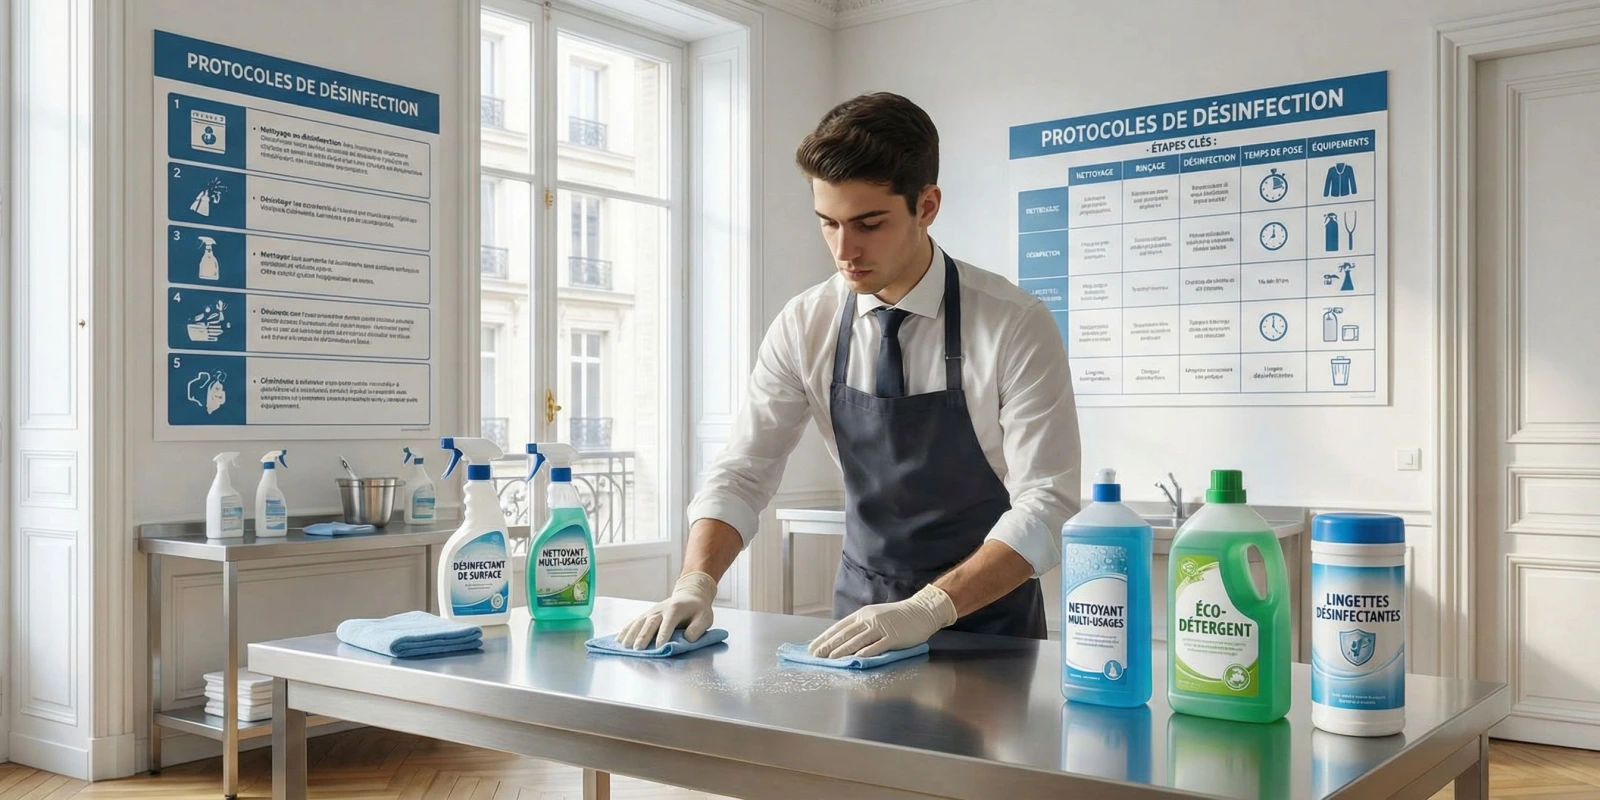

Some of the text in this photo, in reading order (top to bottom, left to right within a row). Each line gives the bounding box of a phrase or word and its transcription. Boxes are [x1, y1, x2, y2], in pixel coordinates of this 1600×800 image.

[187, 52, 419, 118] PROTOCOLES DE DÉSINFECTION
[174, 98, 180, 109] 1
[1041, 87, 1345, 148] PROTOCOLES DE DÉSINFECTION
[1151, 138, 1186, 154] ÉTAPES
[1188, 136, 1212, 149] CLÉS
[1311, 136, 1370, 153] ÉQUIPEMENTS
[1183, 152, 1237, 168] DÉSINFECTION
[1243, 145, 1304, 161] TEMPS DE POSE
[173, 167, 182, 178] 2
[1076, 168, 1114, 180] NETTOYAGE
[1135, 161, 1167, 174] RINÇAGE
[173, 230, 181, 241] 3
[172, 292, 181, 303] 4
[173, 357, 181, 369] 5
[542, 548, 585, 558] NETTOYANT
[453, 559, 506, 571] DÉSINFECTANT
[538, 556, 588, 567] MULTI-USAGES
[457, 570, 502, 580] DE SURFACE
[1326, 592, 1390, 608] LINGETTES
[1068, 601, 1125, 618] NETTOYANT
[1195, 600, 1227, 618] ÉCO-
[1316, 604, 1401, 623] DÉSINFECTANTES
[1068, 615, 1125, 629] MULTI-USAGES
[1178, 616, 1253, 638] DÉTERGENT
